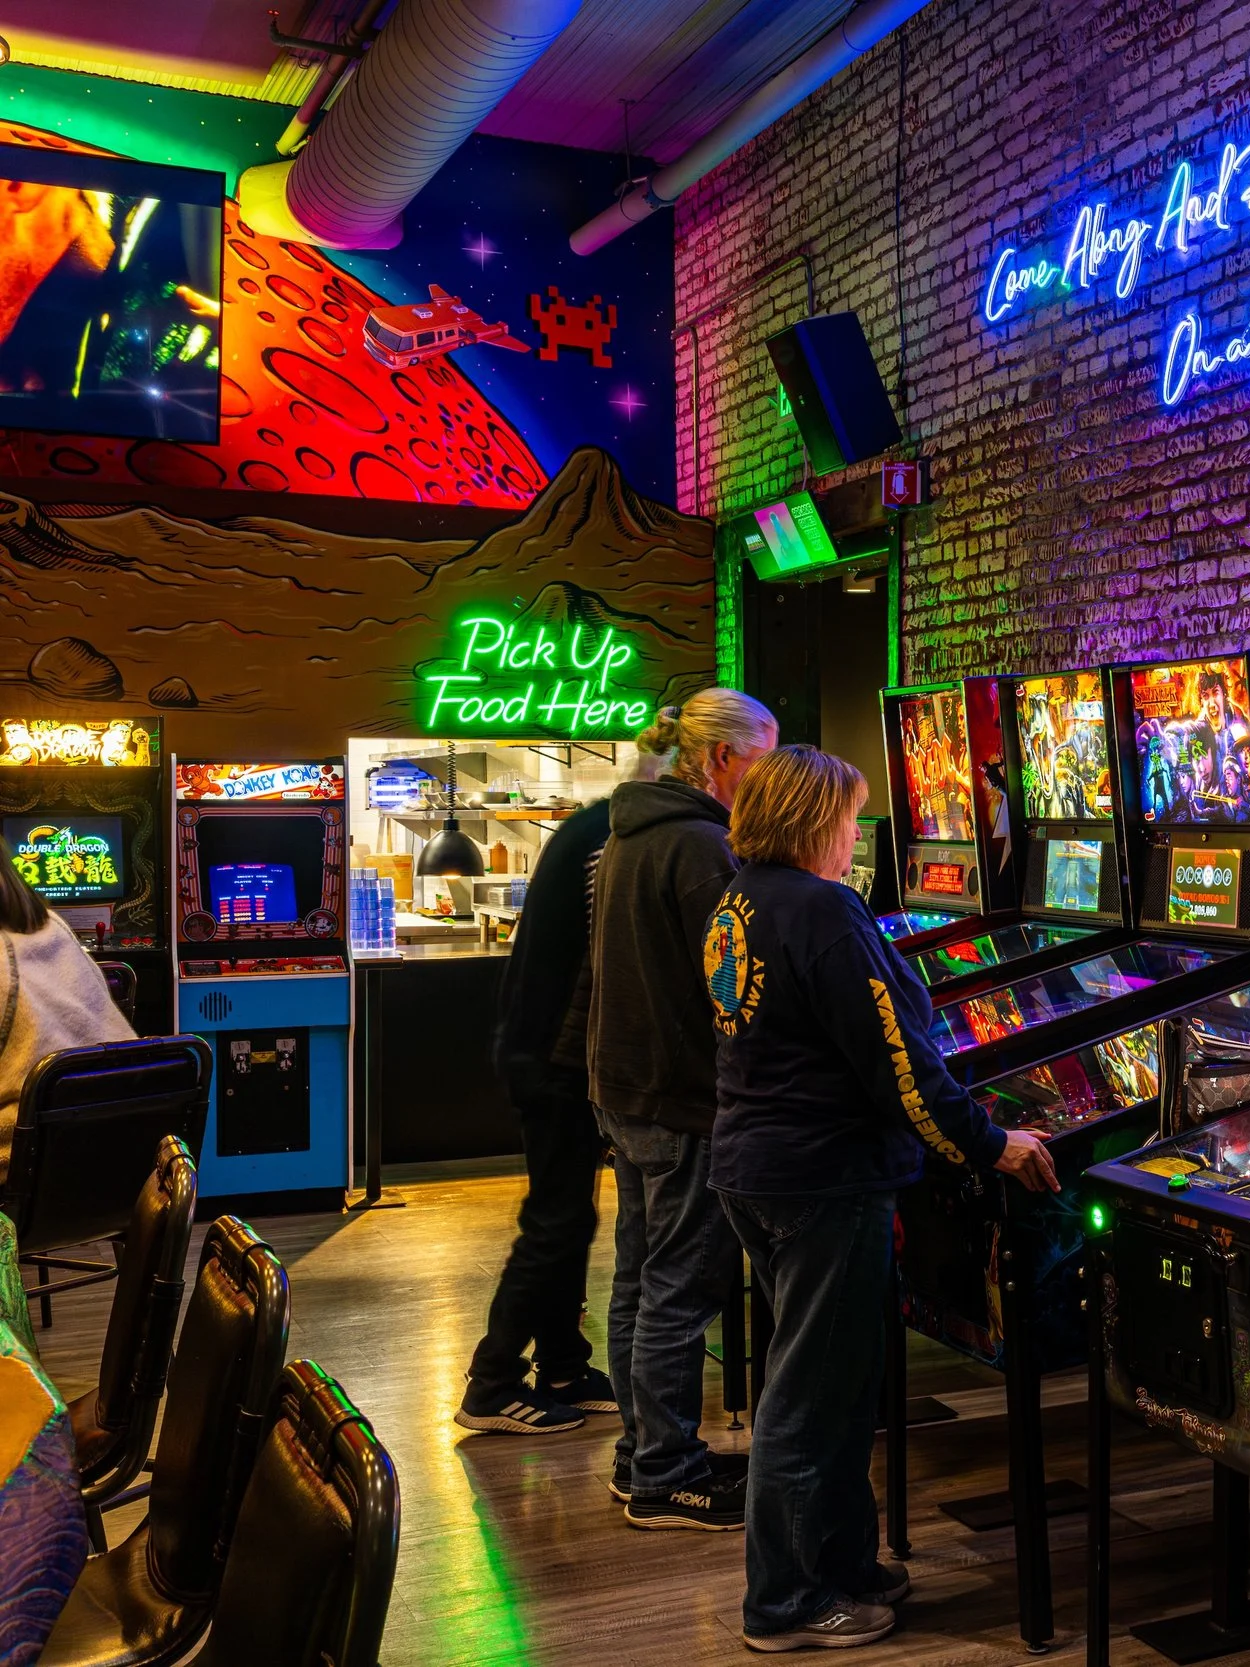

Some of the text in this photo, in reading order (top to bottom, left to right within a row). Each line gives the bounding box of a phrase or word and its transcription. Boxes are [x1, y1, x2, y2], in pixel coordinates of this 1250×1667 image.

[984, 248, 1058, 322] Come
[1062, 203, 1151, 299] Along
[1156, 143, 1237, 252] And
[1163, 315, 1224, 405] On
[460, 617, 631, 693] Pick Up
[425, 675, 647, 732] Food Here
[223, 764, 320, 798] DONKEY KONG
[18, 844, 109, 854] DOUBLE DRAGON
[732, 892, 755, 926] ALL
[740, 956, 765, 1025] AWAY
